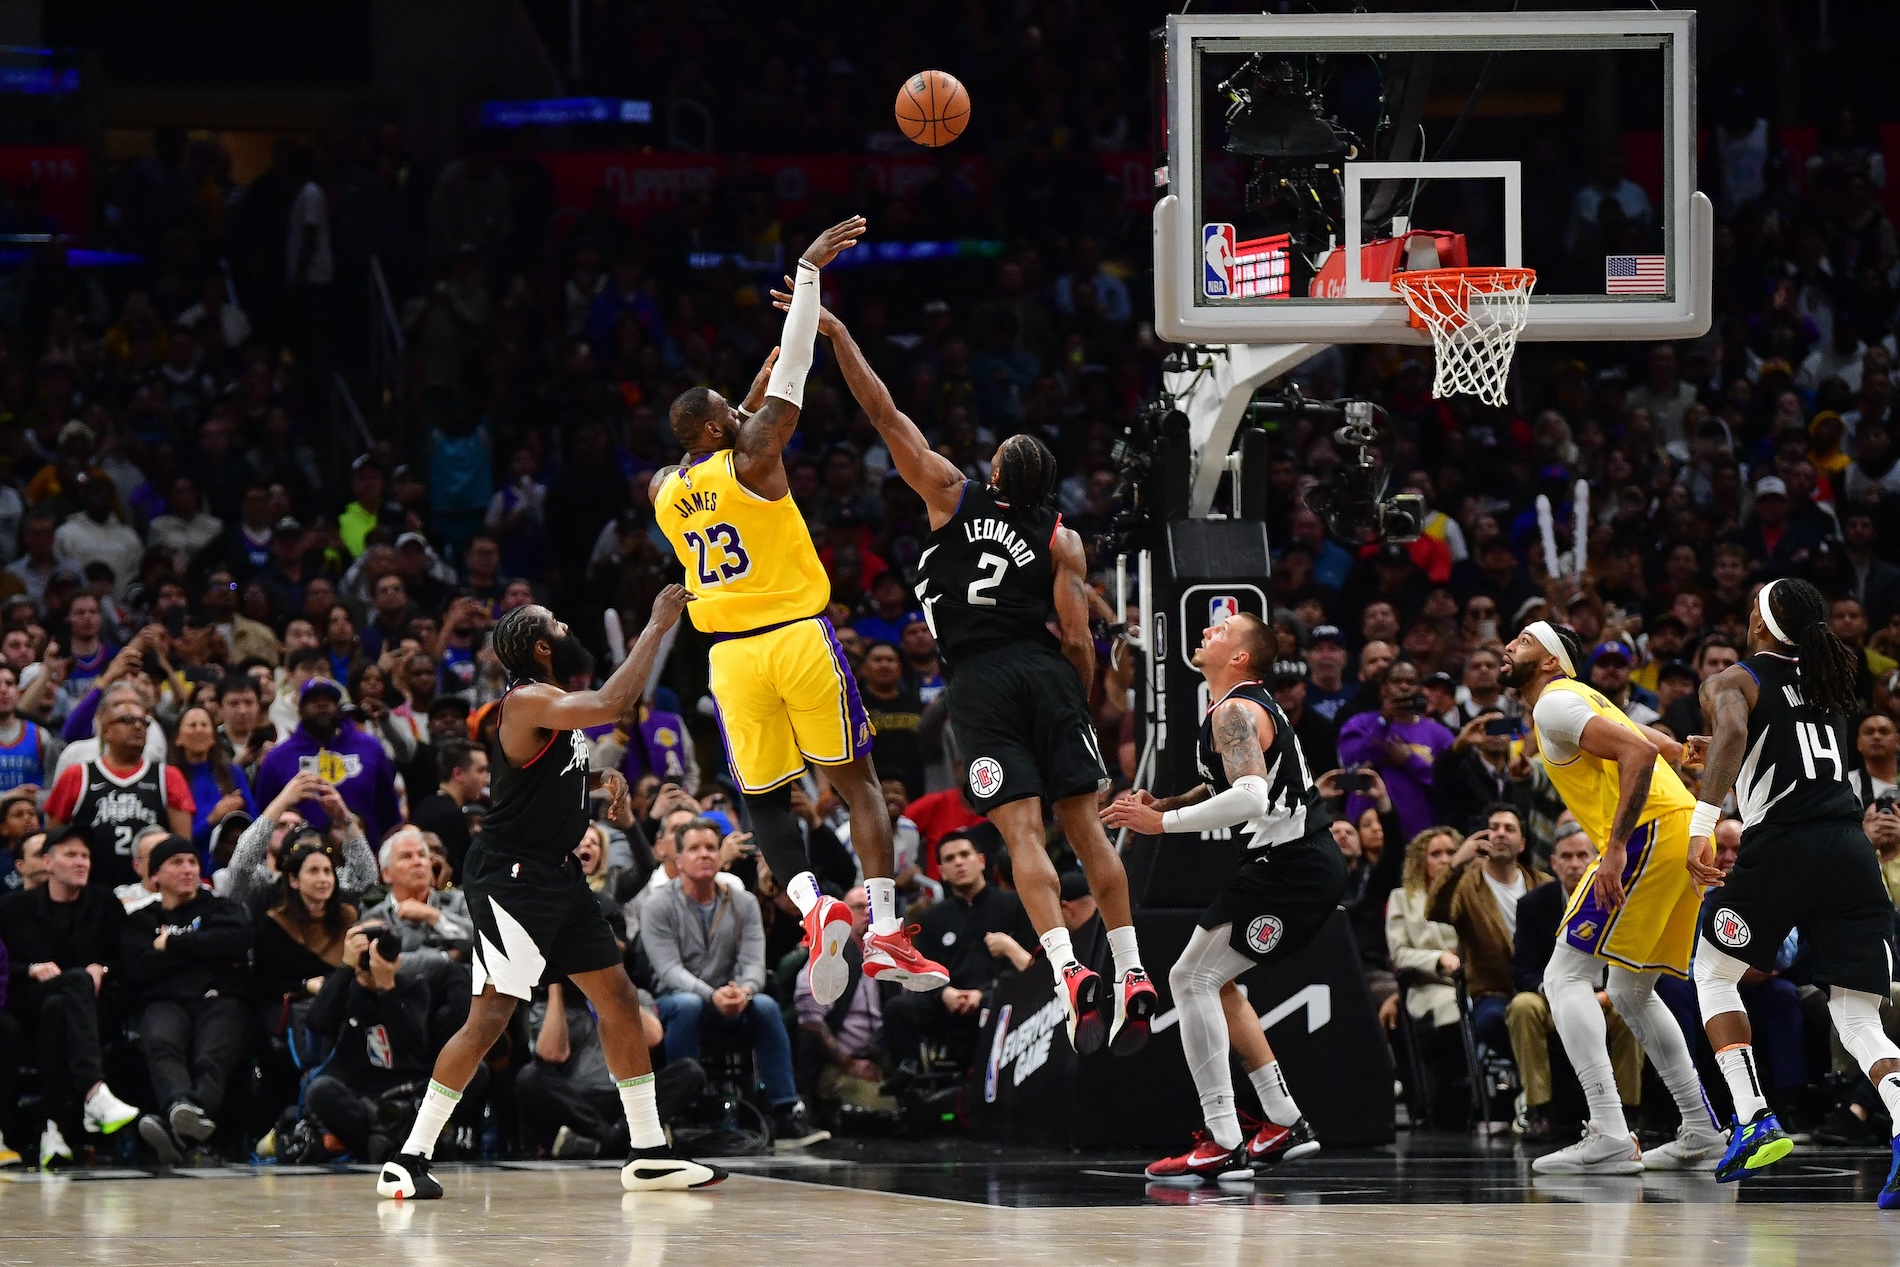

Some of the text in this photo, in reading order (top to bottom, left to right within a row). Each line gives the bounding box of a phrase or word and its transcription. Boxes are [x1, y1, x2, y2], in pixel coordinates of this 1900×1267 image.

[1207, 280, 1224, 293] NBA
[674, 491, 717, 518] JAMES
[682, 521, 752, 588] 23
[963, 518, 1036, 568] LEONARD
[967, 552, 1009, 606] 2
[1795, 721, 1843, 782] 14
[114, 825, 134, 856] 2
